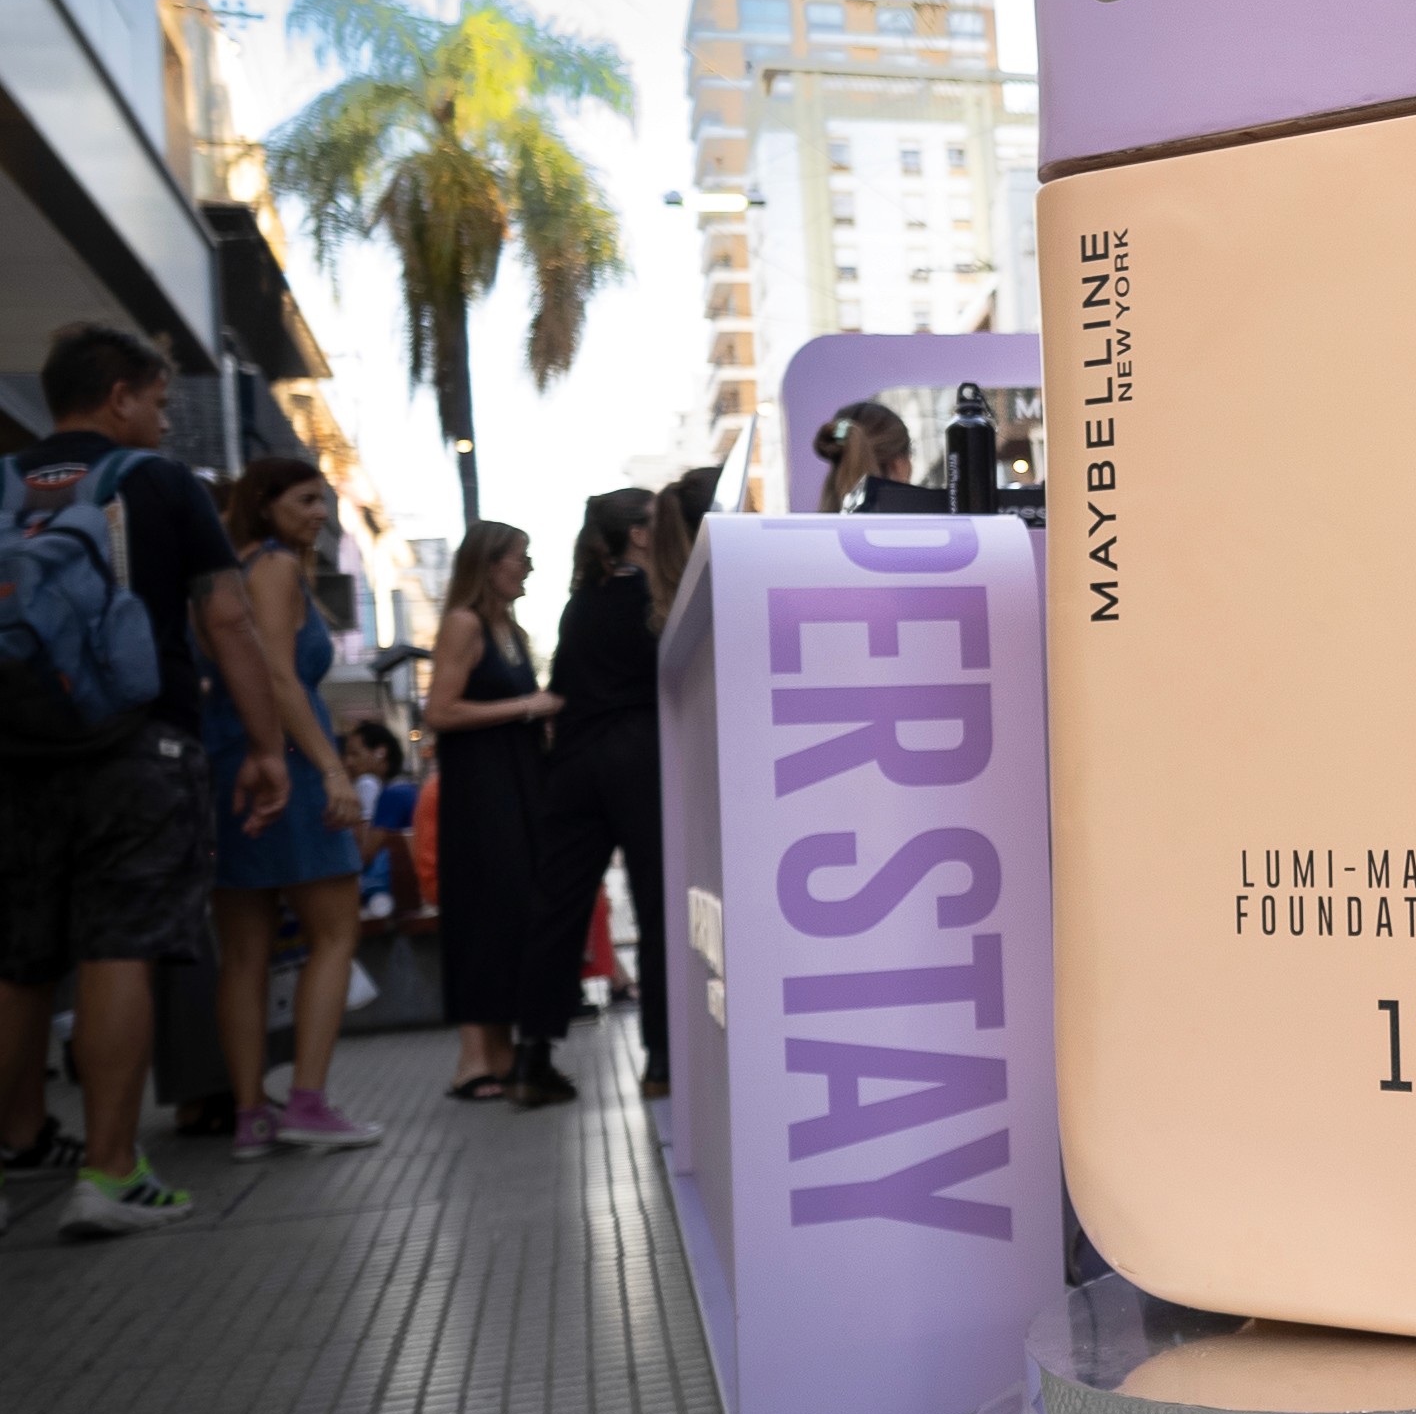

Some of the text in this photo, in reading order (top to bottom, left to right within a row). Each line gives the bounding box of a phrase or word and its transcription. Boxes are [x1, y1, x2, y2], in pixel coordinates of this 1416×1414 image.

[1080, 229, 1119, 622] MAYBELLINE
[1113, 227, 1133, 402] NEW YORK
[775, 826, 1013, 1244] STAY
